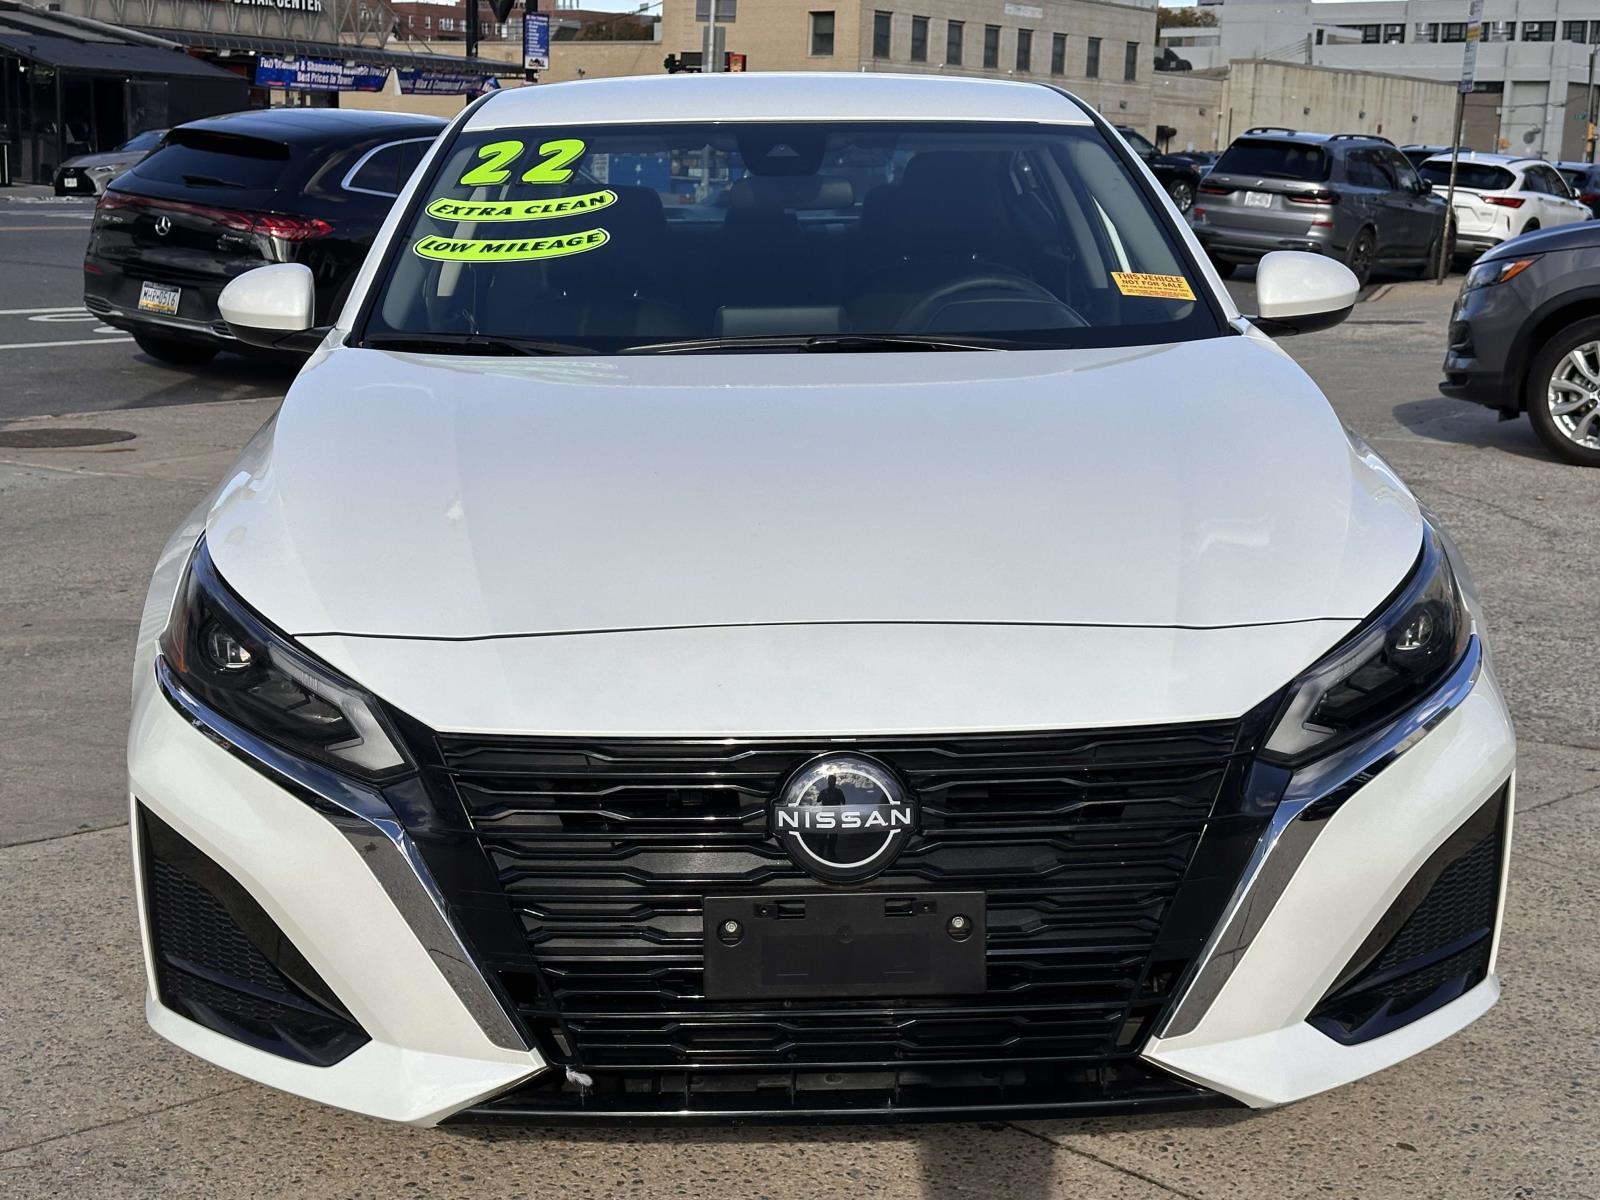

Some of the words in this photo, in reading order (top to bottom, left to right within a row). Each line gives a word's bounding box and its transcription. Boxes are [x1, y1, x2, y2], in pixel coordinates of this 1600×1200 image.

[277, 0, 321, 12] CENTER
[297, 71, 310, 82] Best
[311, 73, 328, 84] Prices
[460, 139, 586, 187] 22
[434, 204, 512, 216] EXTRA
[524, 195, 606, 215] CLEAN
[420, 240, 476, 253] LOW
[479, 233, 601, 254] MILEAGE
[1140, 274, 1183, 283] VEHICLE
[778, 808, 911, 829] NISSAN
